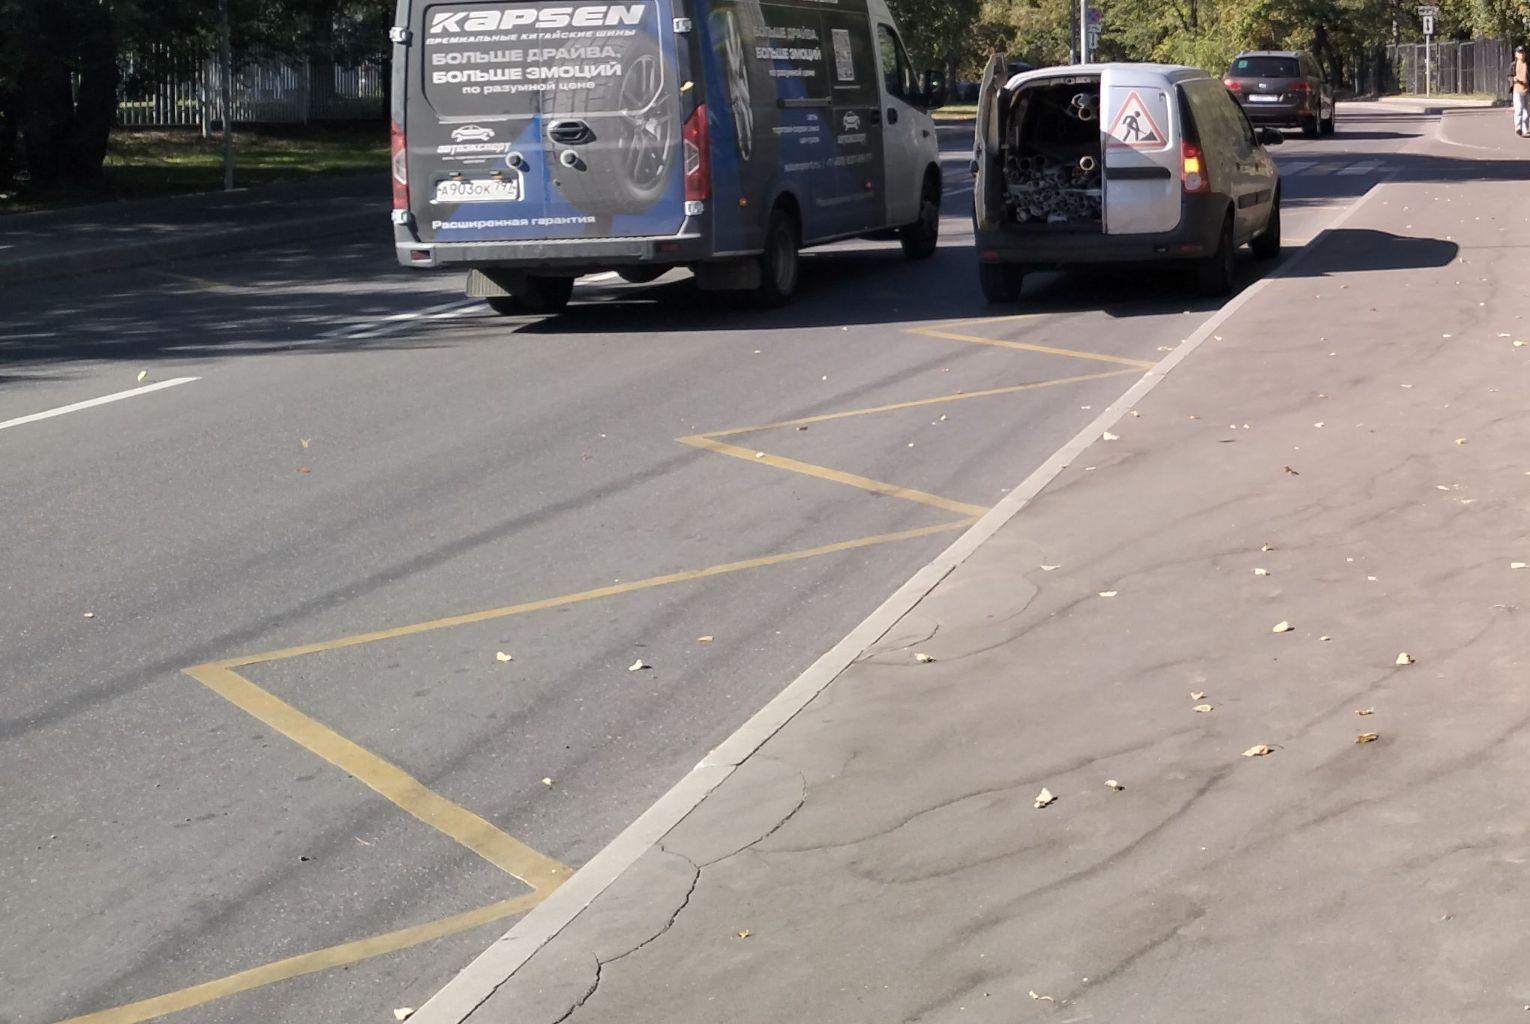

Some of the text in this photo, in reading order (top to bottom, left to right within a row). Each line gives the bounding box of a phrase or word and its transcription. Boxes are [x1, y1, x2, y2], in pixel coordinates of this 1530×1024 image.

[425, 28, 636, 45] ПРЕМИАЛЬНЫЕ КИТАЙСКИЕ ШИНЫ
[431, 44, 622, 66] БОЛЬШЕ ДРАЙВА,
[432, 62, 622, 84] БОЛЬШЕ ЭМОЦИЙ
[483, 81, 556, 96] разумной
[431, 215, 597, 230] Расширенная гарантия
